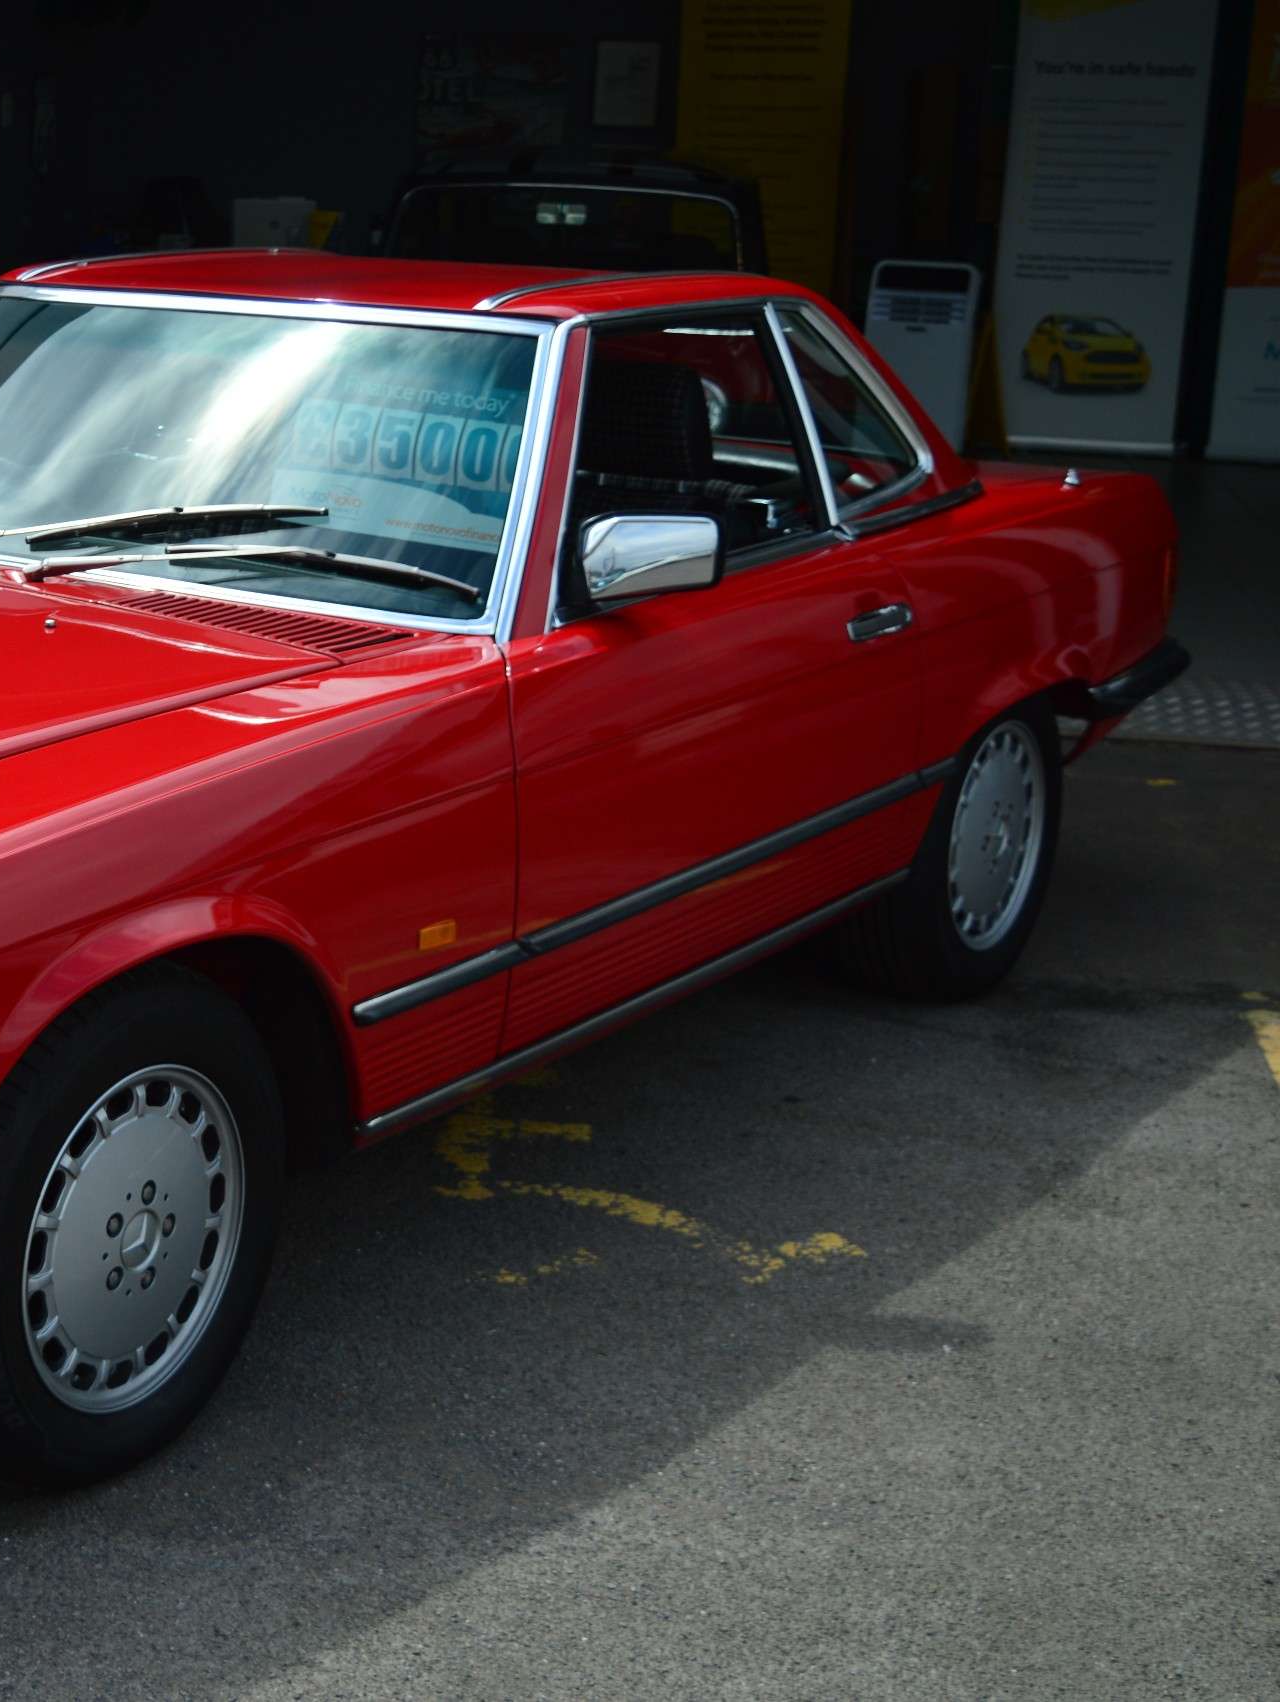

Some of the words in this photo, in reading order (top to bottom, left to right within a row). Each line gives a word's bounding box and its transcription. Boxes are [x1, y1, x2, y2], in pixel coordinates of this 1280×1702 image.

[1087, 60, 1104, 76] in
[1108, 61, 1142, 77] safe
[417, 390, 449, 406] me
